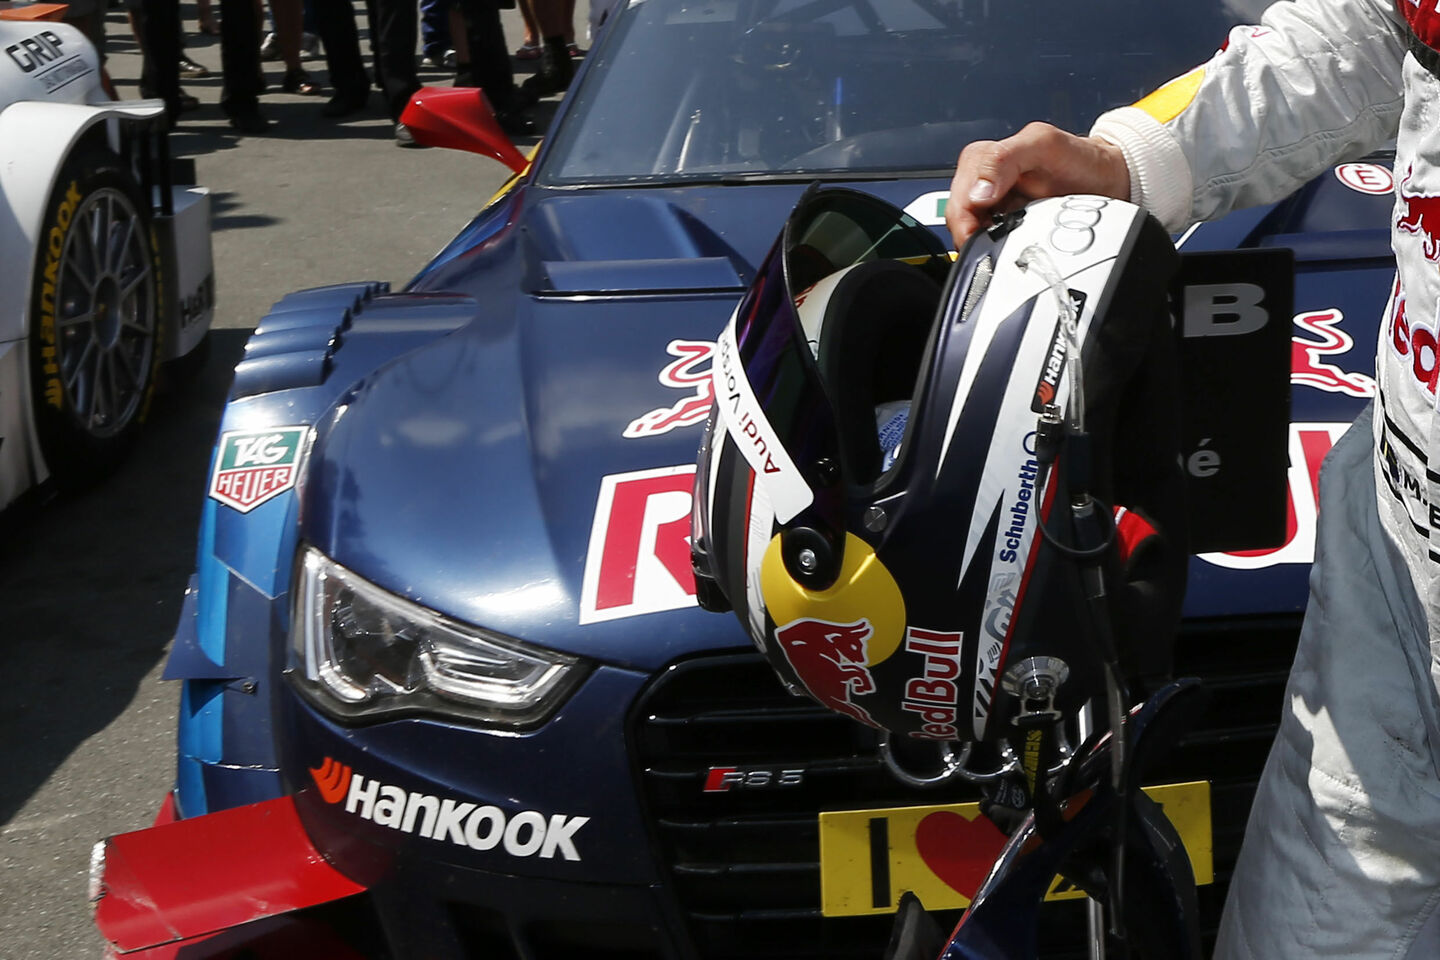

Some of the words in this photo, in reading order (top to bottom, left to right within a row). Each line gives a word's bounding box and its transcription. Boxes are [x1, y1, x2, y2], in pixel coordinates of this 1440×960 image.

[5, 30, 64, 73] GRIP
[233, 434, 289, 466] TAG
[738, 411, 782, 474] Audi
[216, 468, 290, 502] HEUER
[1403, 472, 1428, 506] M.
[1000, 460, 1038, 563] Schuberth
[345, 774, 591, 862] Hankook
